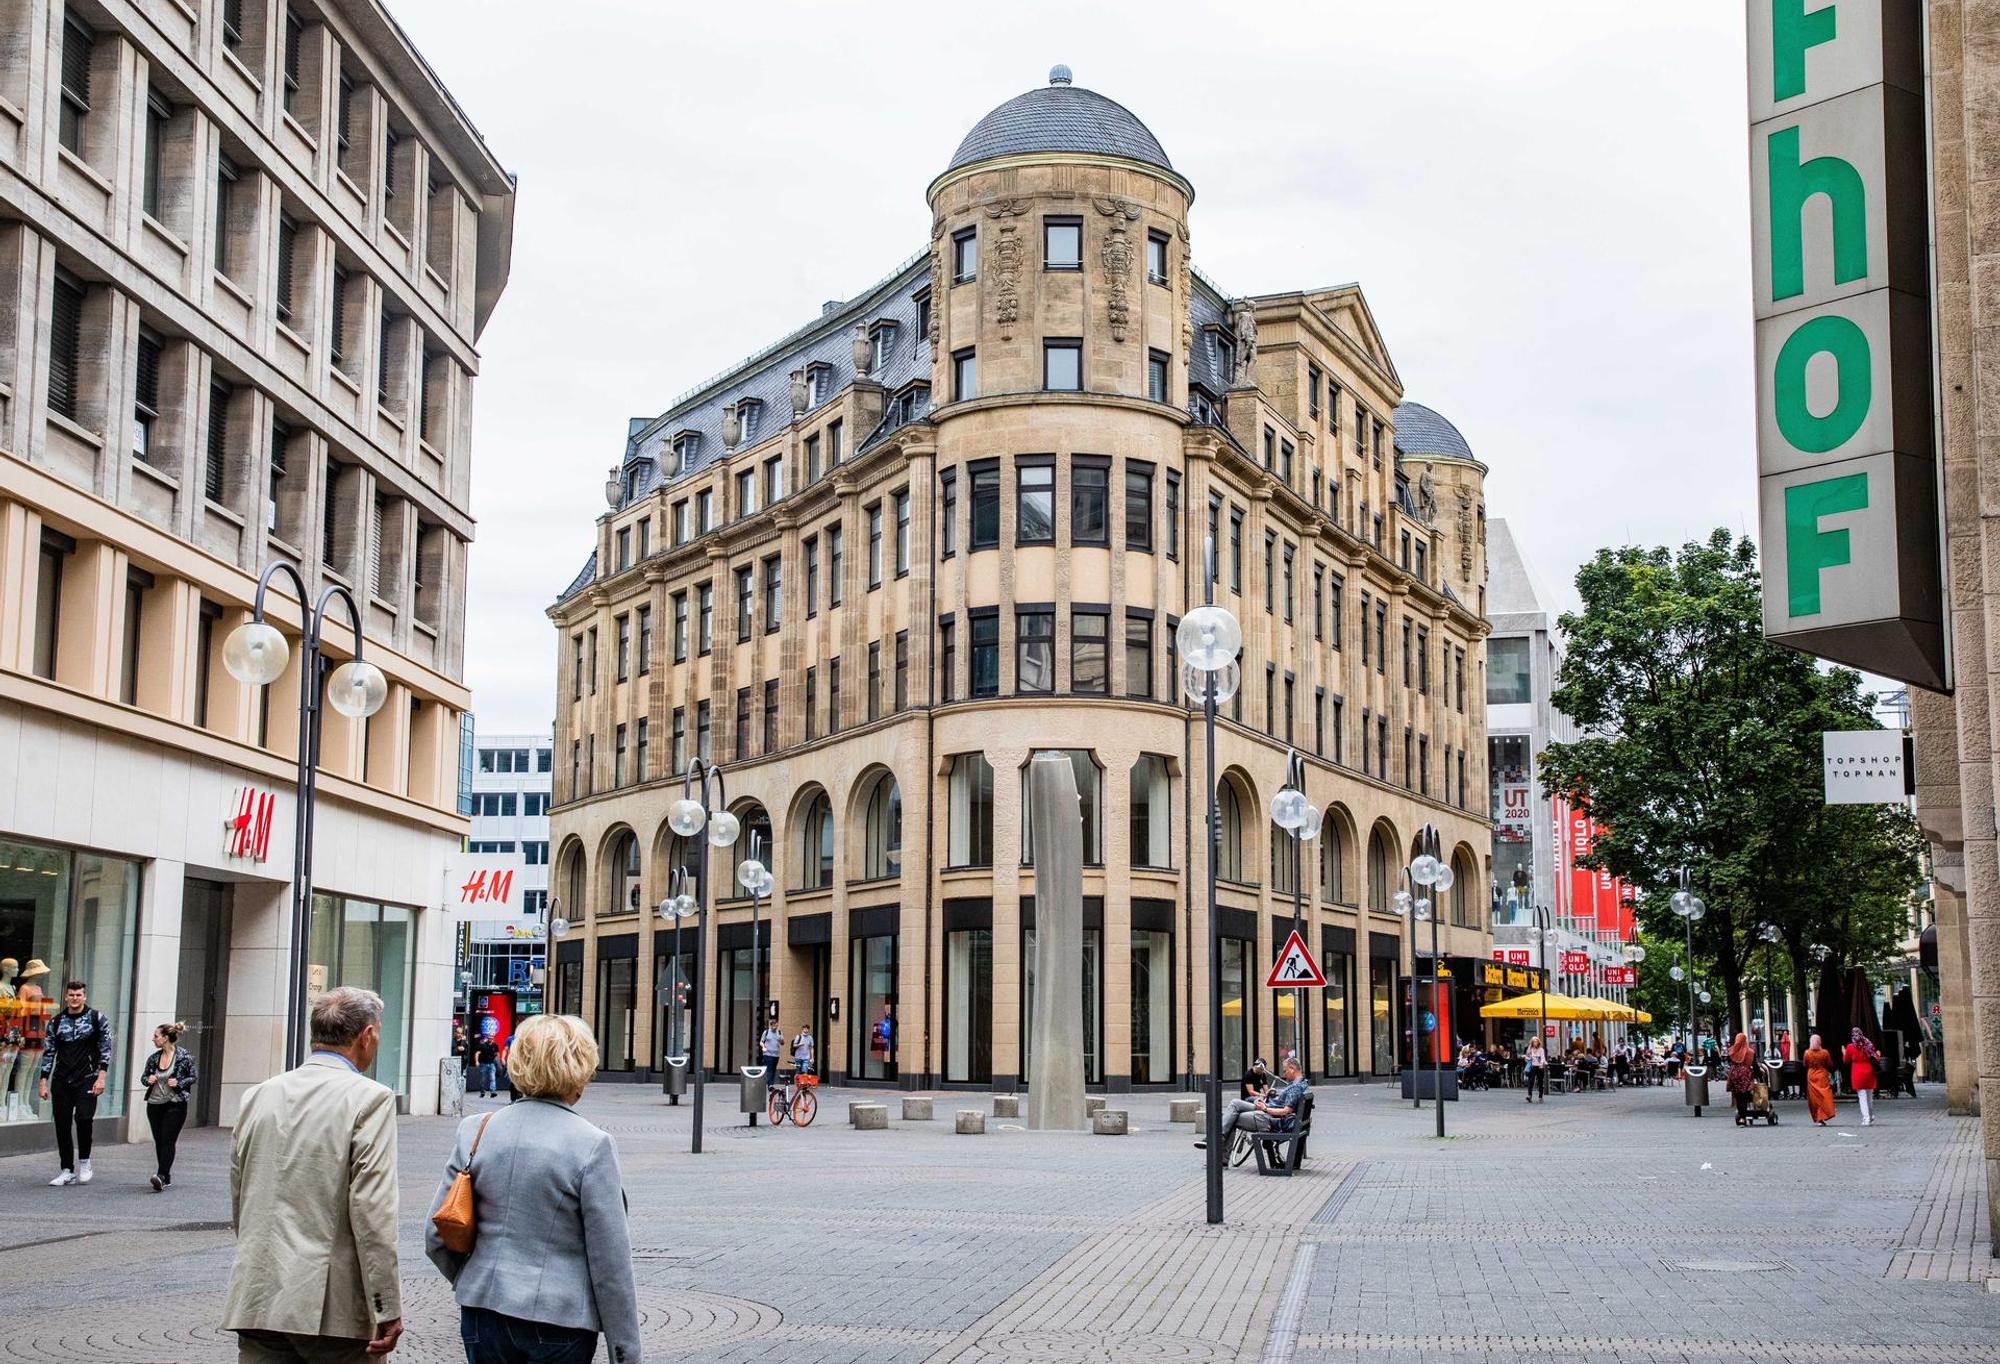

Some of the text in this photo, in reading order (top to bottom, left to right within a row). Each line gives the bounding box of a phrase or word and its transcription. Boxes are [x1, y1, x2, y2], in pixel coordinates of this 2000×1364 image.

[1827, 756, 1901, 765] TOPSHOP
[1833, 770, 1896, 778] TOPMAN
[1504, 789, 1529, 808] UT
[1505, 808, 1530, 819] 2020
[225, 786, 275, 864] H&M
[461, 869, 514, 905] H&M
[1510, 952, 1526, 960] UNI
[1568, 955, 1585, 963] UNI
[1568, 964, 1585, 973] QLO
